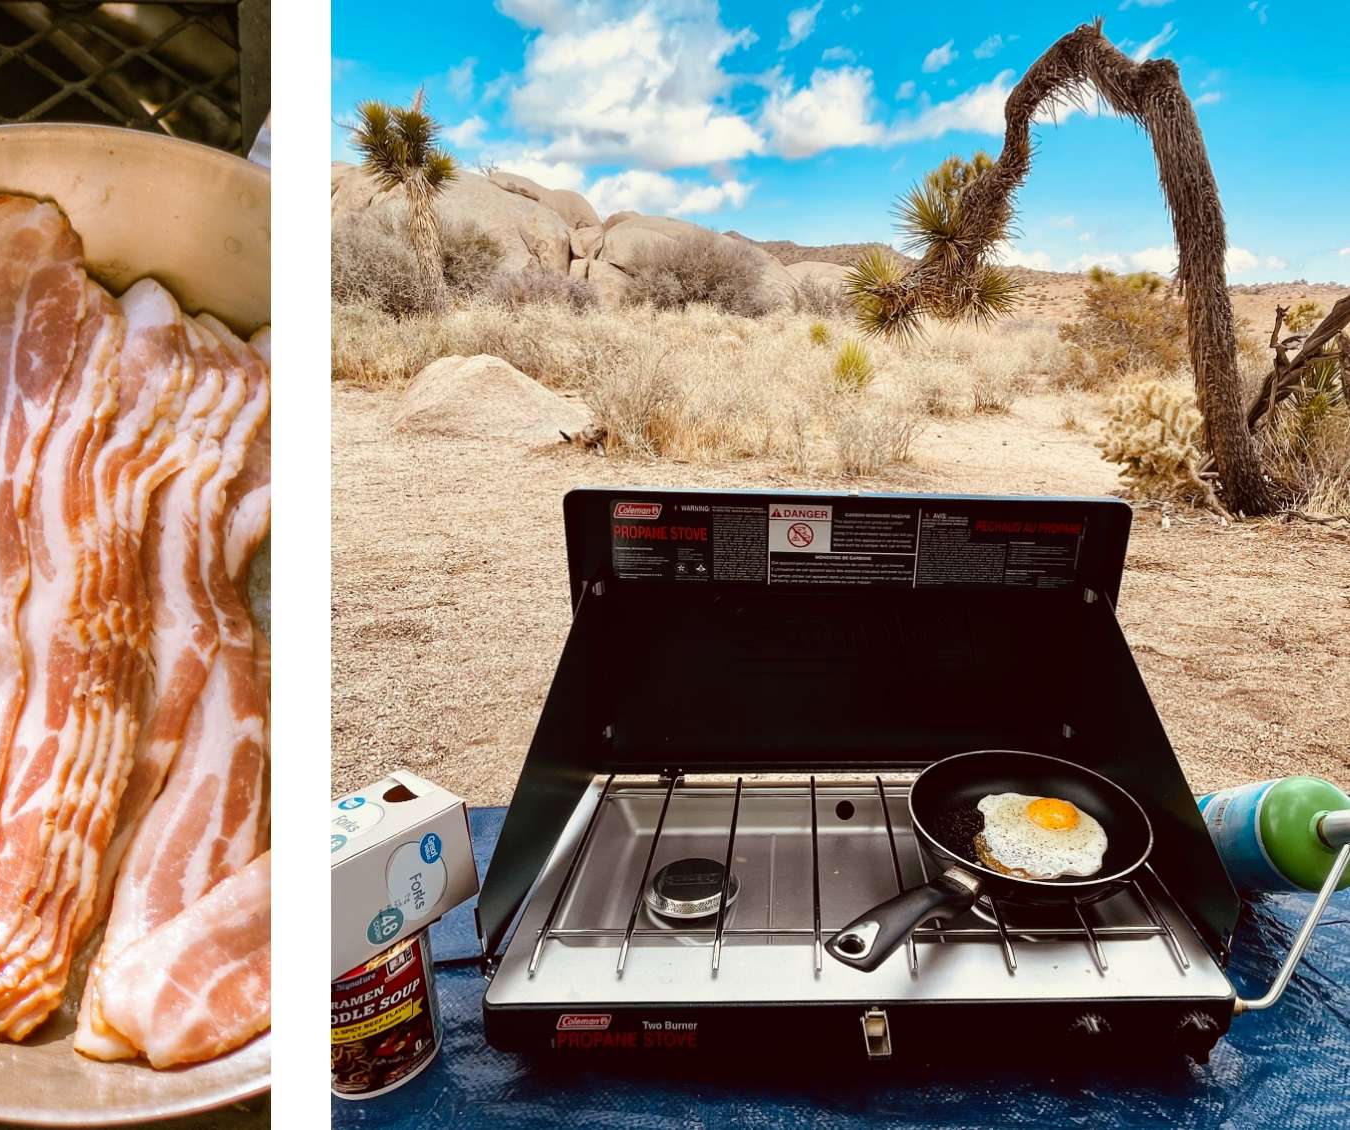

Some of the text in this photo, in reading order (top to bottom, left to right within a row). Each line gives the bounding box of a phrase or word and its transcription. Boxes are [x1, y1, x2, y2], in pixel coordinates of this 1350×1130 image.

[618, 505, 651, 515] Coleman
[784, 509, 828, 519] DANGER
[614, 525, 708, 541] PROPANE STOVE
[428, 835, 439, 858] Great
[409, 872, 425, 910] Forks
[380, 915, 398, 935] 48
[336, 972, 376, 991] Signature
[331, 984, 385, 1009] RAMEN
[379, 977, 420, 1010] SOUP
[385, 1001, 411, 1020] FLAVOR
[562, 1016, 599, 1026] Coleman
[642, 1021, 698, 1030] Two Burner
[557, 1032, 697, 1047] PROPANE STOVE
